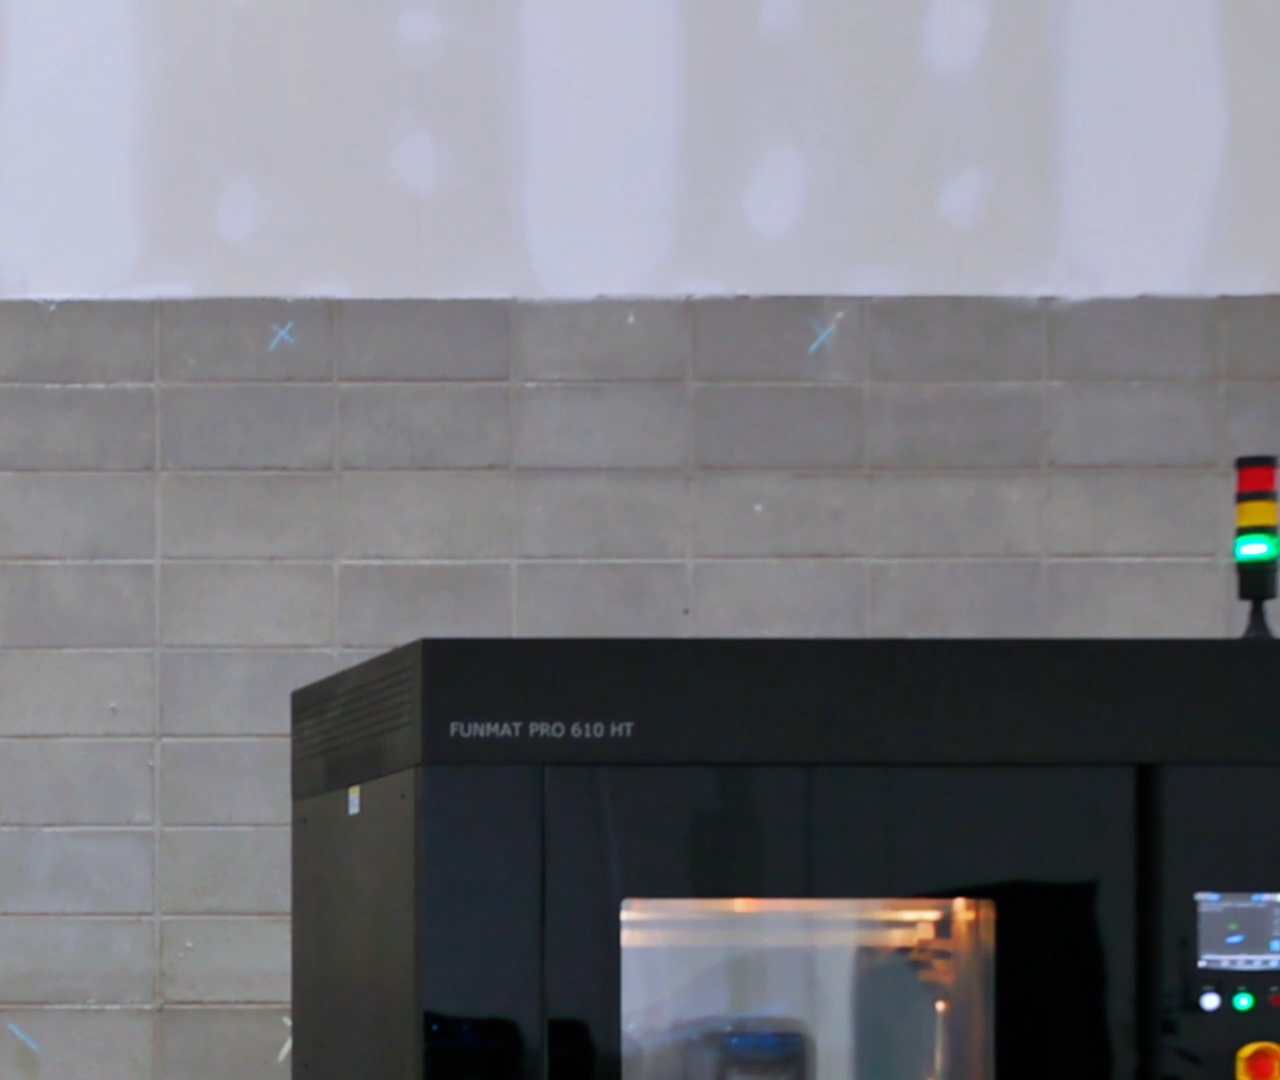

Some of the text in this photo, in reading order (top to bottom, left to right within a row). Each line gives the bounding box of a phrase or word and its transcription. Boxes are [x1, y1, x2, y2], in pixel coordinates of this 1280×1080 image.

[449, 721, 634, 738] FUNMAT PRO 610 HT
